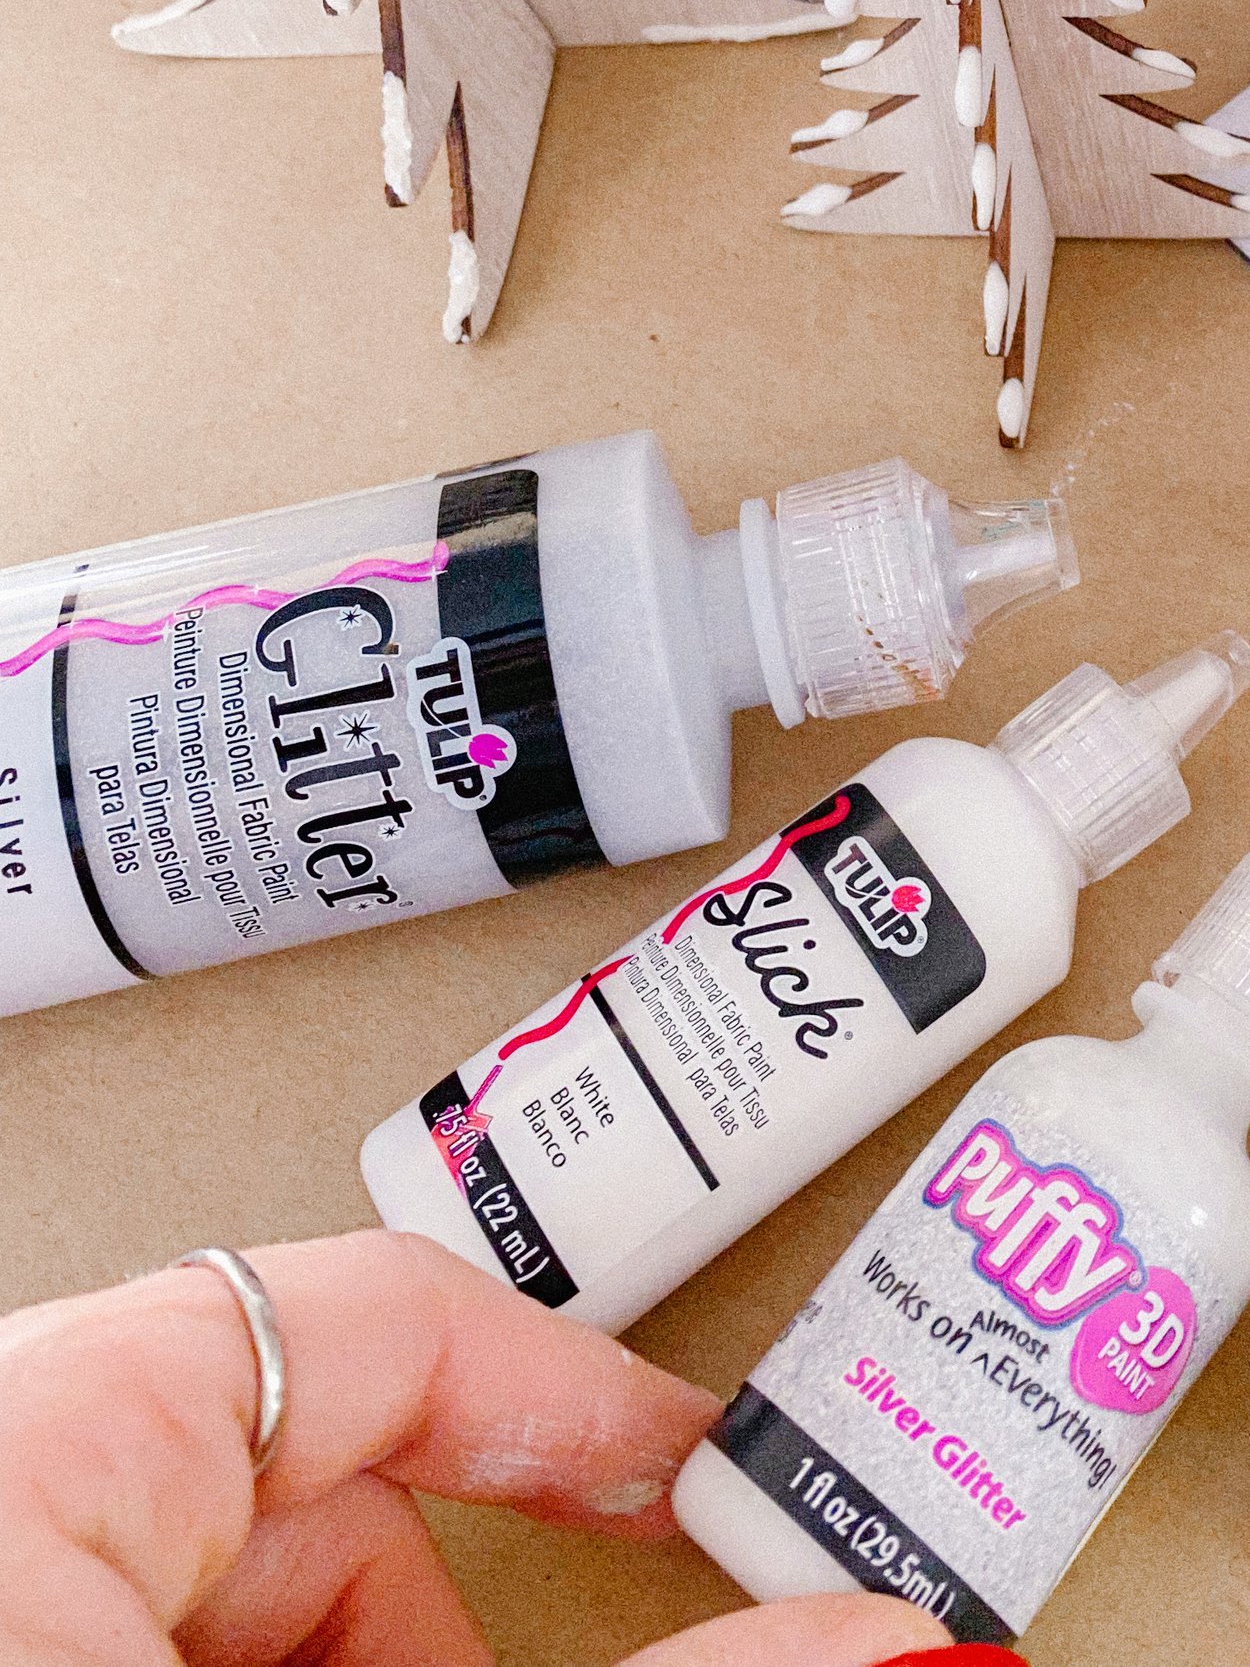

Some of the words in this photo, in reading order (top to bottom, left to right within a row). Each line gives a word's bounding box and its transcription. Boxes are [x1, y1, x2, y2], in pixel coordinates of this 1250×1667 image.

[173, 607, 205, 690] Peinture
[130, 693, 161, 776] Pintura
[218, 652, 265, 793] Dimensional
[255, 587, 413, 908] Glitter
[415, 648, 485, 798] TULIP
[89, 765, 124, 816] para
[175, 695, 229, 866] Dimensionnelle
[0, 767, 33, 894] Silver
[106, 818, 140, 875] Telas
[139, 779, 202, 905] Dimensional
[239, 797, 281, 861] Fabric
[205, 868, 247, 909] pour
[230, 905, 266, 939] Tissu
[259, 863, 300, 905] Paint
[833, 843, 917, 946] TULIP
[674, 935, 729, 1006] Dimensional
[717, 1000, 751, 1046] Fabric
[744, 1041, 776, 1082] Paint
[703, 881, 864, 1059] Slick
[624, 956, 650, 994] Pintura
[641, 987, 699, 1065] Dimensional
[685, 1067, 716, 1101] para
[710, 1095, 739, 1136] Telas
[640, 932, 669, 972] Peinture
[660, 965, 725, 1060] Dimensionnelle
[713, 1057, 746, 1092] pour
[740, 1086, 770, 1129] Tissu
[522, 1099, 567, 1168] Blanco
[550, 1087, 590, 1145] Blanc
[575, 1065, 616, 1128] White
[449, 1130, 479, 1157] fl
[460, 1155, 487, 1187] oz
[473, 1183, 519, 1232] (22
[501, 1230, 550, 1284] mL)
[970, 1309, 1050, 1363] Almost
[1118, 1291, 1185, 1367] 3D
[861, 1248, 931, 1323] Works
[930, 1316, 973, 1355] on
[990, 1357, 1115, 1489] Everything!
[1097, 1344, 1156, 1401] PAINT
[842, 1355, 935, 1442] Silver
[931, 1433, 1028, 1530] Glitter
[788, 1457, 815, 1489] 1
[802, 1470, 838, 1510] fl
[822, 1496, 862, 1537] oz
